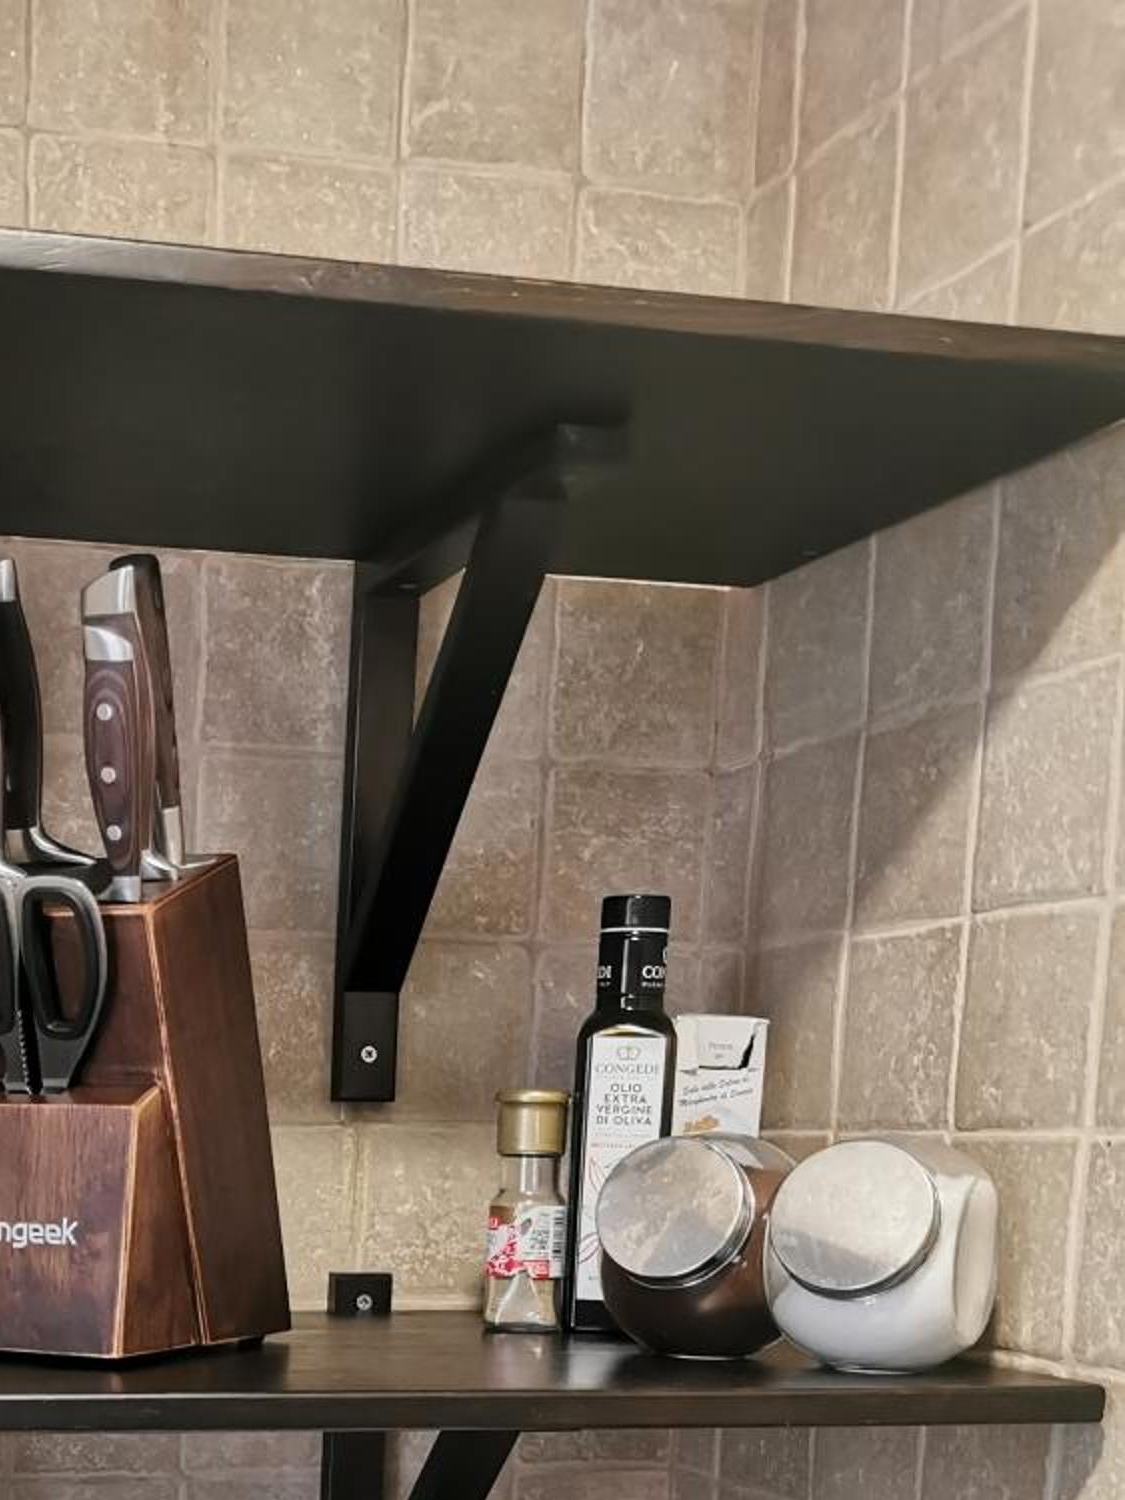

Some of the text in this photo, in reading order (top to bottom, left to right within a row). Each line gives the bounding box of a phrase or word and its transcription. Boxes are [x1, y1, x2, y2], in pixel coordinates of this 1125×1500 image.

[596, 1063, 659, 1074] CONGEDI
[610, 1083, 642, 1093] OLIO
[605, 1094, 647, 1104] EXTRA
[596, 1105, 652, 1115] VERGINE
[596, 1116, 652, 1125] DI OLIVA
